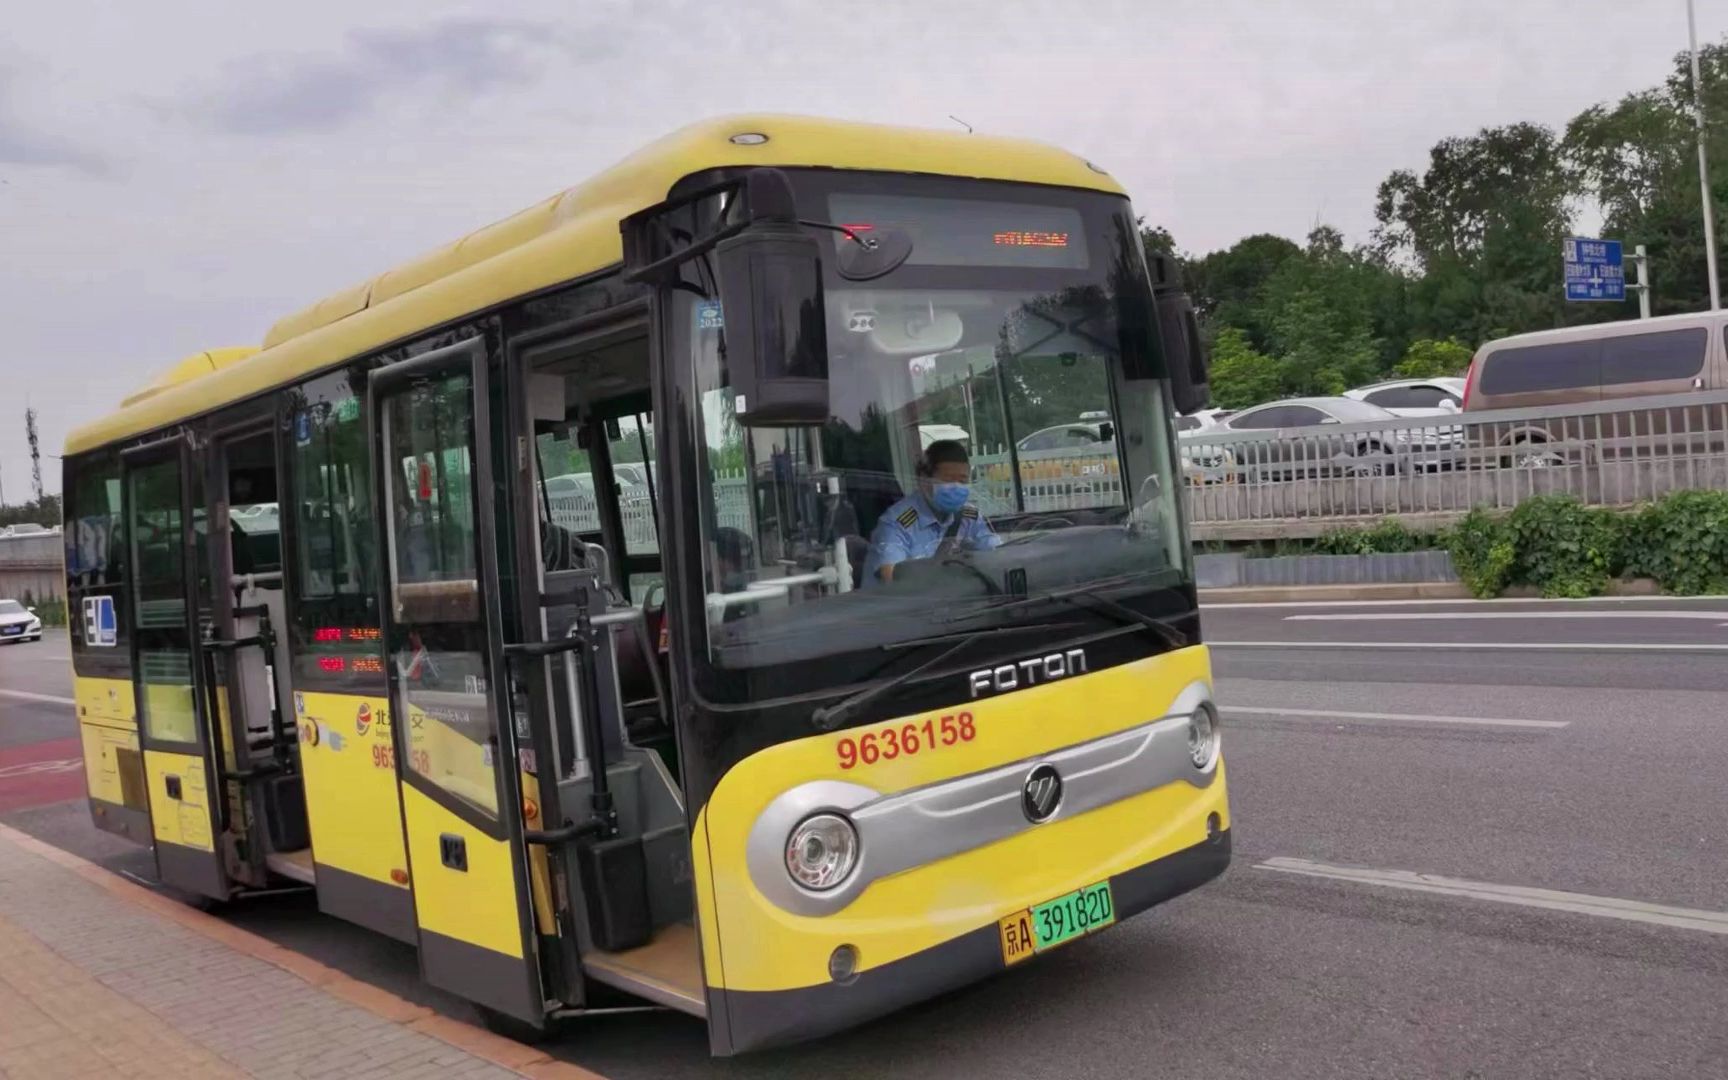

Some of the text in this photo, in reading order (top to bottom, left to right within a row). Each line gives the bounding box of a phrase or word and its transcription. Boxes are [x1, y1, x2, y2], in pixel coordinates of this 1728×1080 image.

[969, 648, 1087, 698] FOTON
[837, 711, 976, 770] 9636158
[1039, 886, 1111, 942] 39182D
